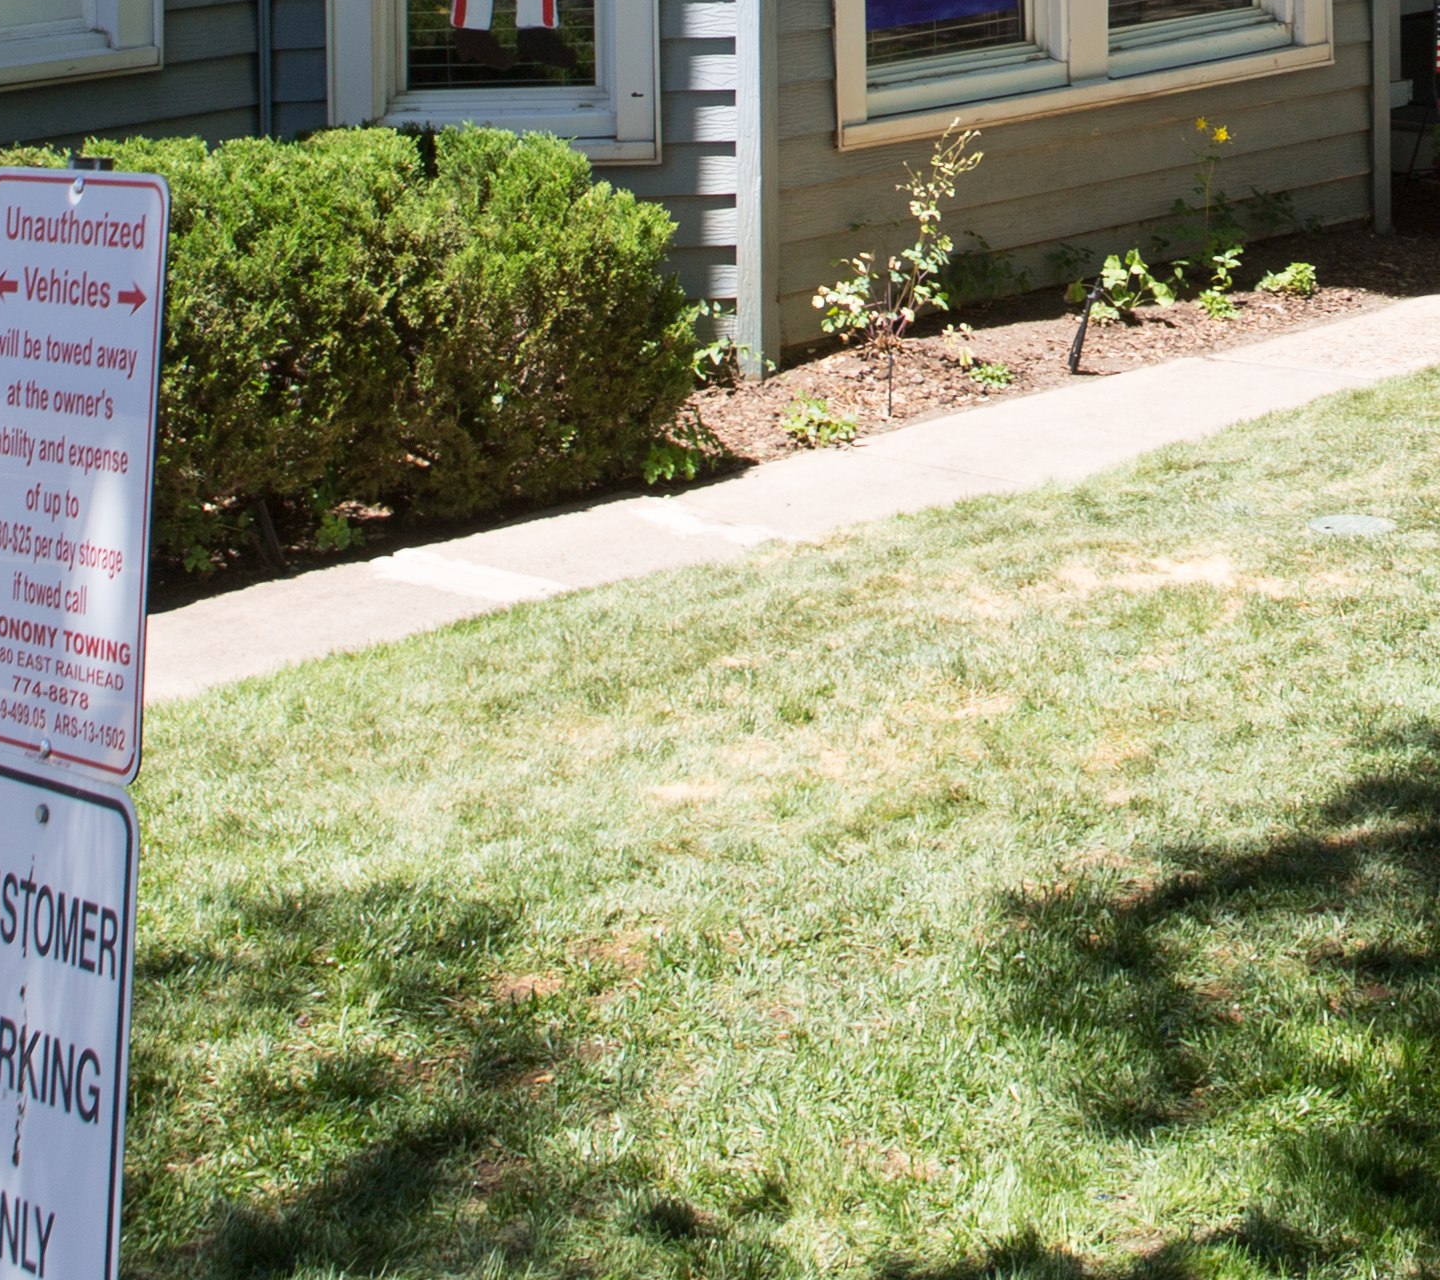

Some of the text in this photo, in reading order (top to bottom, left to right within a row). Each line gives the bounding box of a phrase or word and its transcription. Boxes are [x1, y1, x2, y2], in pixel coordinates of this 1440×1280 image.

[6, 205, 147, 250] Unauthorized
[24, 266, 112, 309] Vehicles
[23, 330, 42, 360] be
[46, 334, 94, 366] towed
[96, 345, 138, 380] away
[7, 379, 114, 420] at the owner's
[39, 435, 66, 465] and
[68, 443, 129, 475] expense
[26, 482, 80, 523] of up to
[33, 534, 54, 565] per
[55, 532, 77, 572] day
[78, 539, 123, 580] storage
[12, 572, 88, 615] if towed call
[63, 630, 132, 667] TOWING
[17, 650, 53, 674] EAST
[55, 659, 125, 692] RAILHEAD
[11, 675, 90, 711] 774-8878
[53, 712, 127, 752] ARS-13-1502
